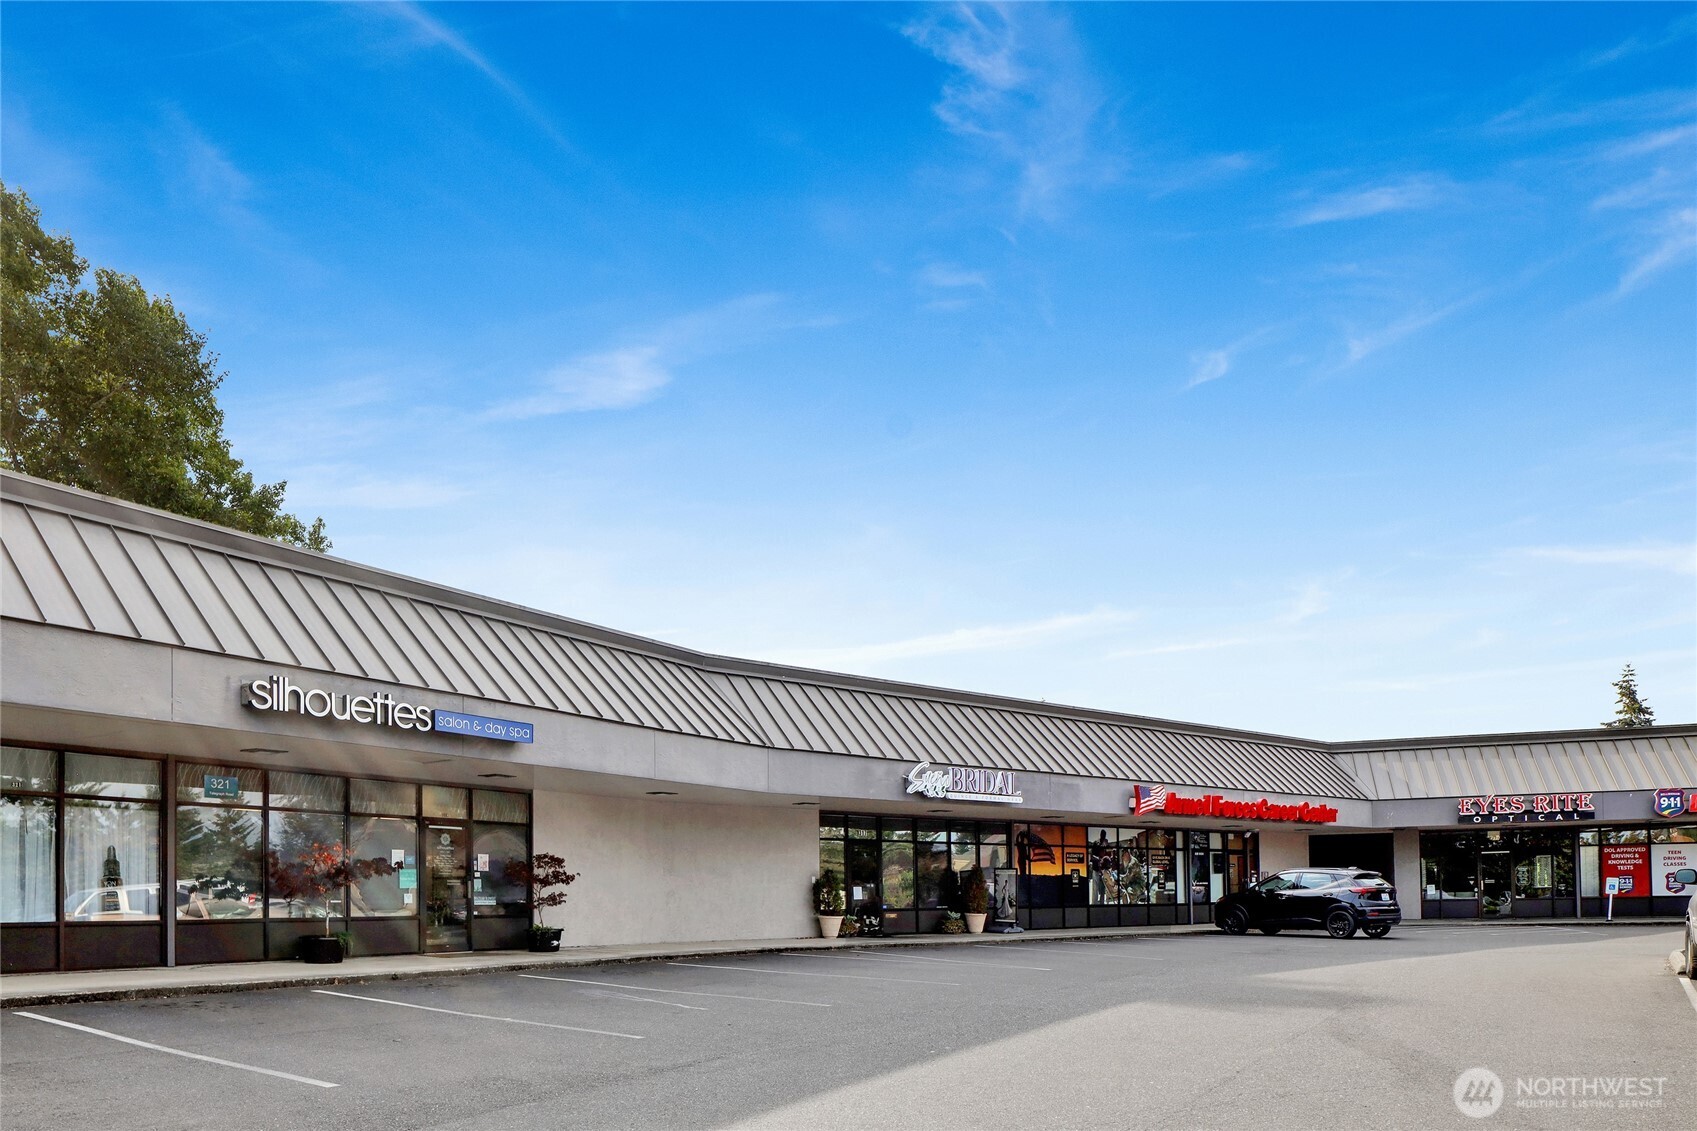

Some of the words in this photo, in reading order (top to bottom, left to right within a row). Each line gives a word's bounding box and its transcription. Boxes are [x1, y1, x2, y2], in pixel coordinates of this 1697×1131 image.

[251, 675, 432, 732] silhouettes
[438, 716, 470, 730] salon
[473, 720, 482, 731] &
[484, 721, 507, 737] day
[509, 726, 530, 739] spa
[210, 778, 229, 789] 321
[948, 766, 1022, 796] BRIDAL
[1165, 792, 1211, 816] Armed
[1211, 795, 1257, 819] Forces
[1257, 798, 1299, 821] Career
[1457, 794, 1525, 815] EYES
[1532, 793, 1595, 814] RITE
[1473, 813, 1579, 823] OPTICAL
